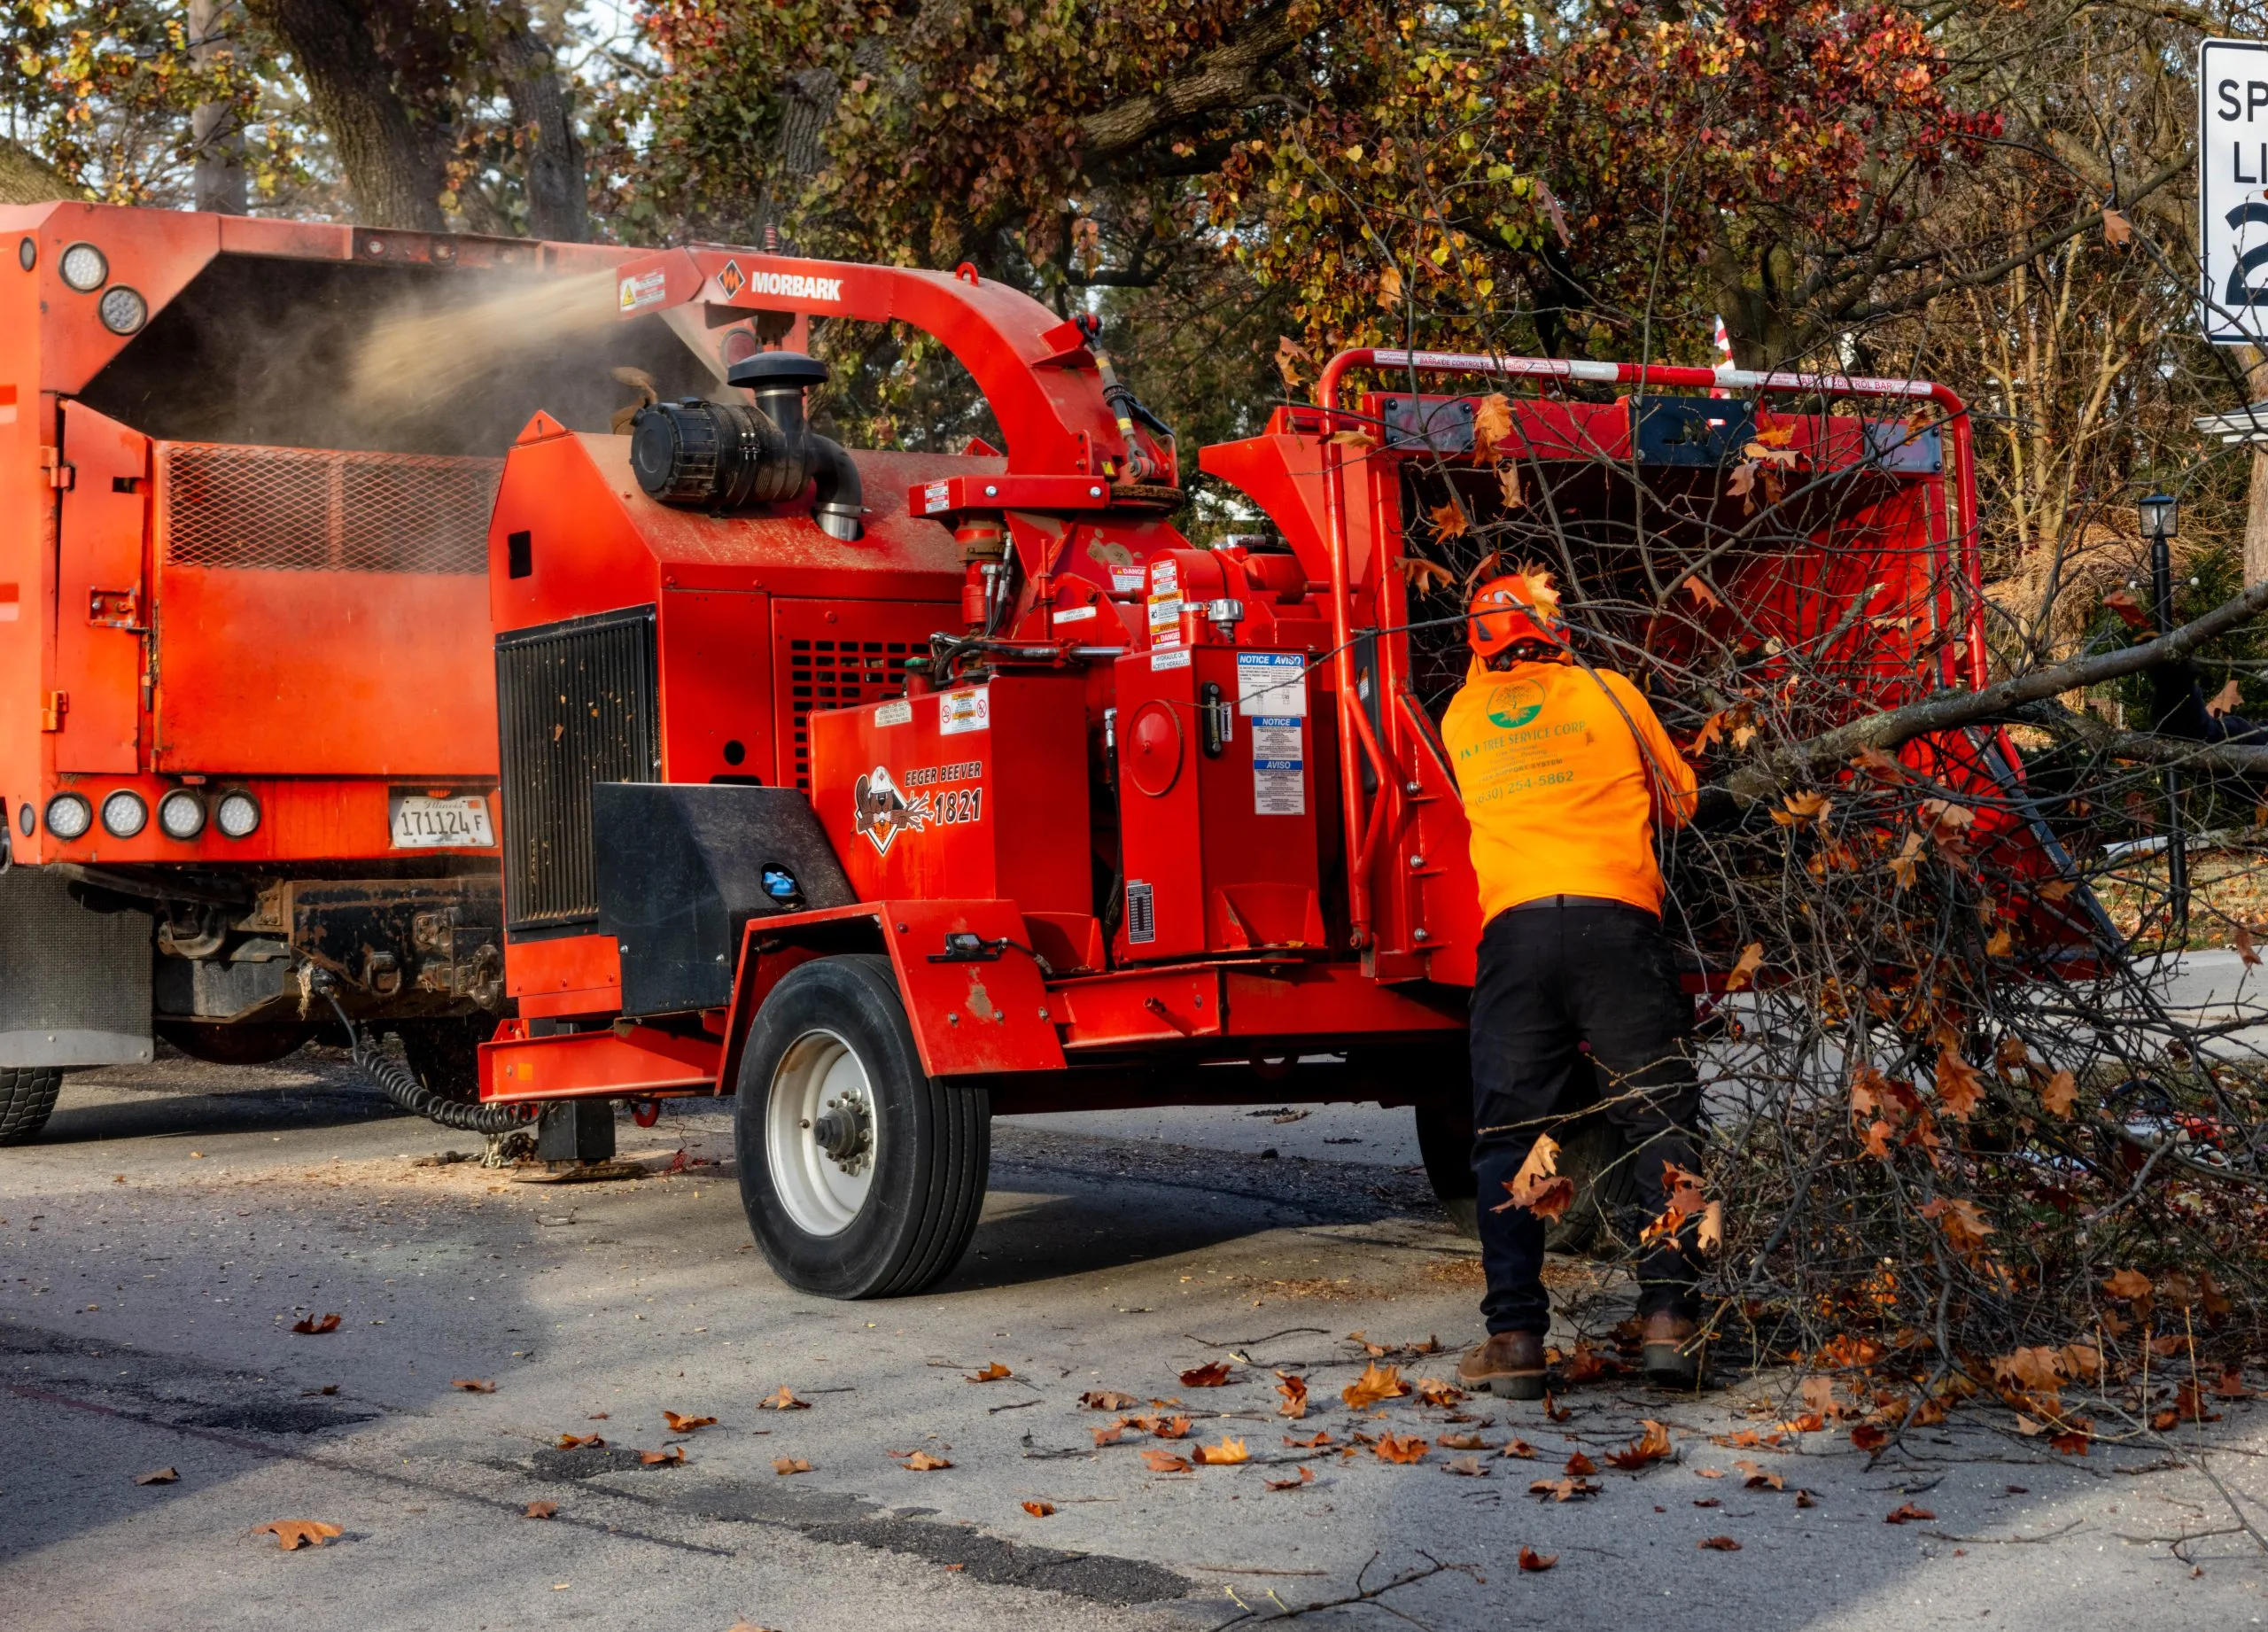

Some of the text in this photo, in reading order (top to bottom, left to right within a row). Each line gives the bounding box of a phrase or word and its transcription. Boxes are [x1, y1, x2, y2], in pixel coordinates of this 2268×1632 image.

[2225, 202, 2268, 306] 2
[751, 271, 841, 301] MORBARK
[1875, 381, 1892, 390] BAR
[1156, 653, 1177, 662] HYDRAULIC
[1274, 656, 1301, 664] AVISO
[1153, 661, 1166, 670] ACEITE
[1262, 718, 1291, 727] NOTICE
[1483, 736, 1505, 752] TREE
[1508, 727, 1550, 745] SERVICE
[1266, 760, 1291, 769] AVISO
[1530, 758, 1563, 769] SYSTEM
[905, 760, 982, 787] EEGER BEEVER
[1508, 770, 1574, 795] 254-5862
[423, 800, 463, 809] Illinois
[935, 787, 983, 826] 1821
[401, 811, 482, 836] 171124 F
